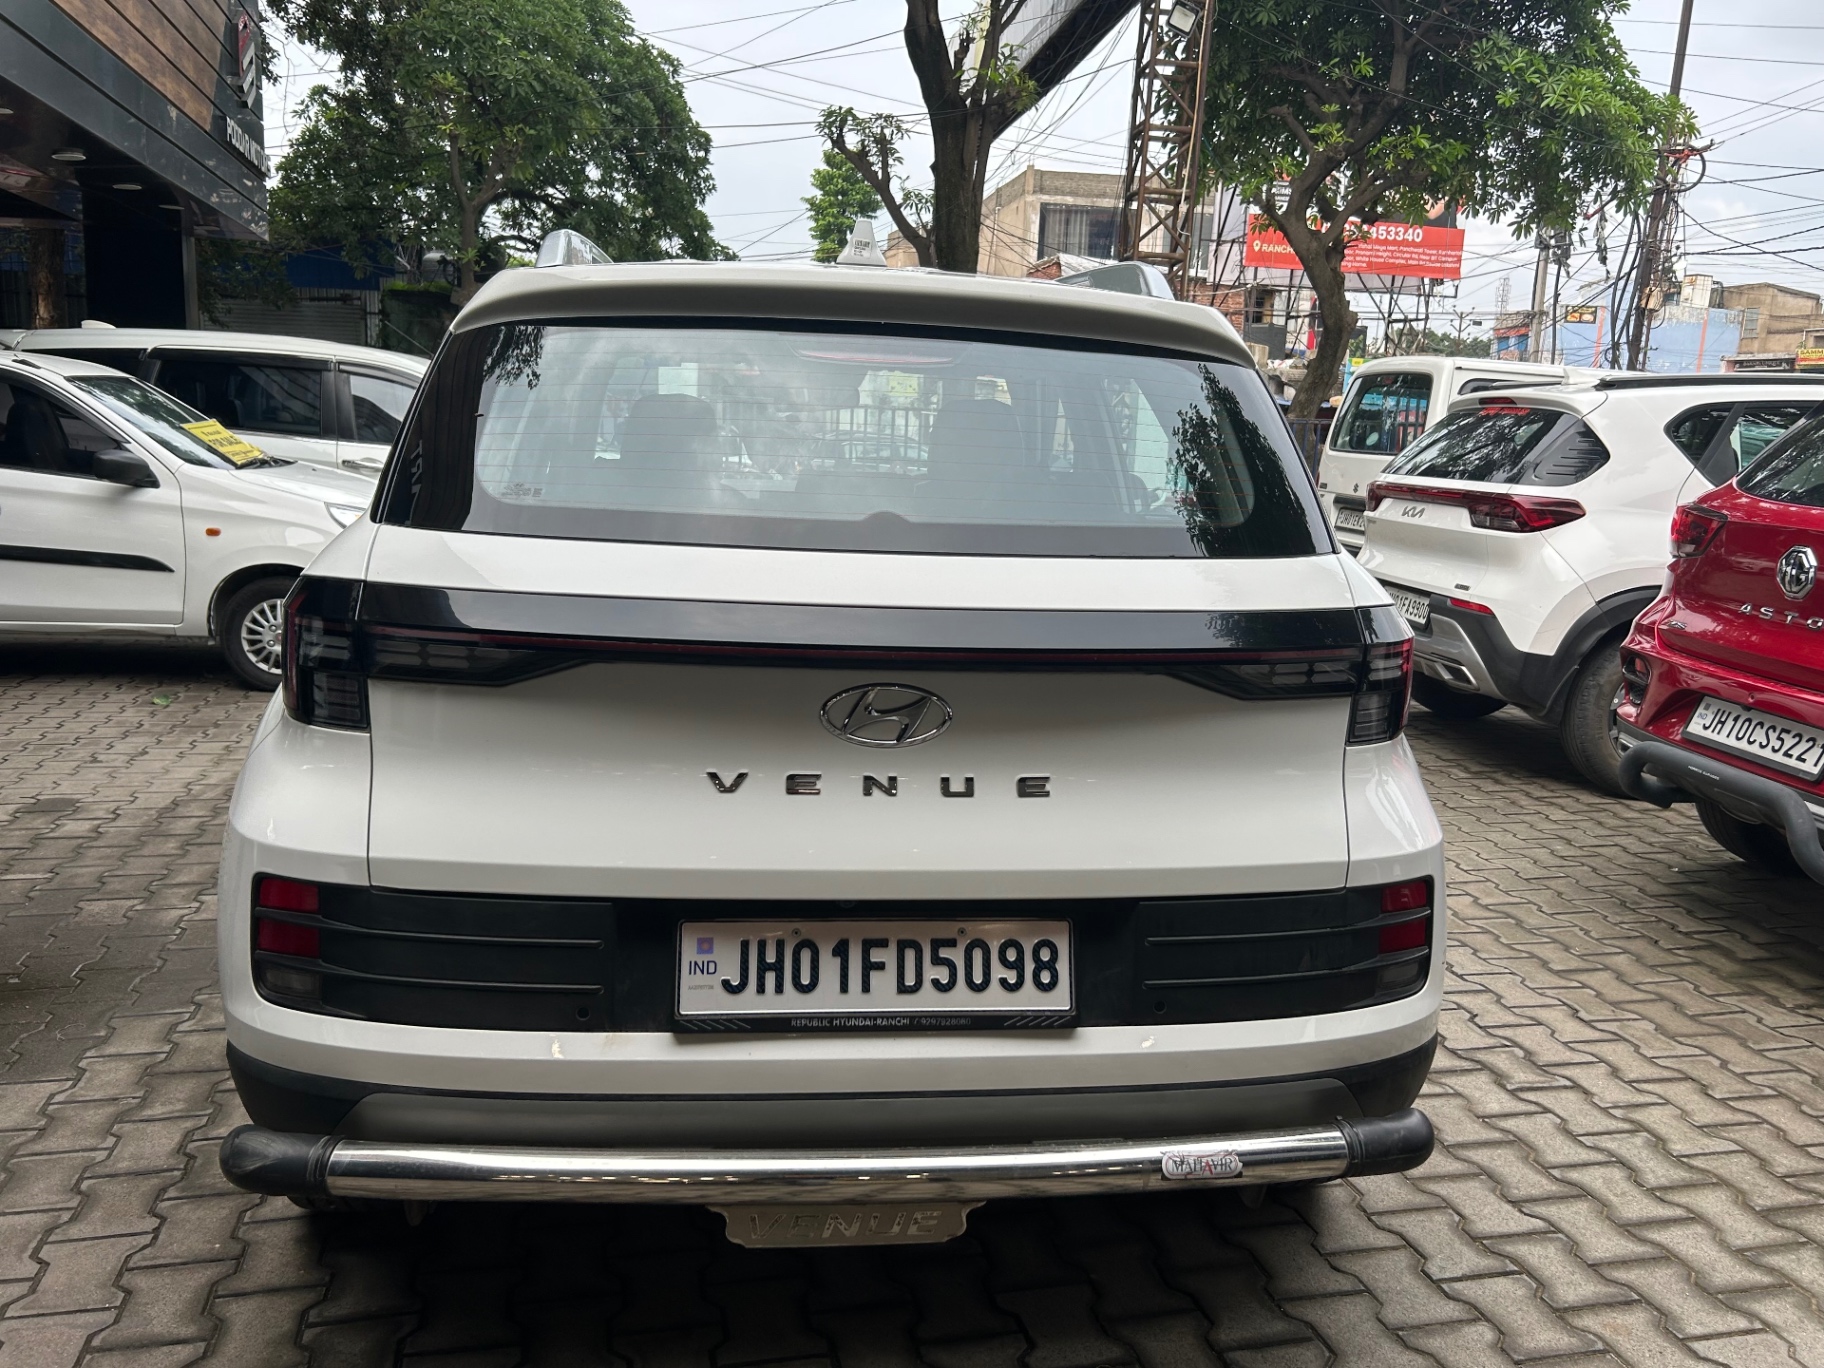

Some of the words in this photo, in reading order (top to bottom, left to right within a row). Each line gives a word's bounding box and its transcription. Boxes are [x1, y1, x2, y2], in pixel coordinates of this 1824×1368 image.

[1262, 243, 1296, 254] RANCH
[1702, 708, 1824, 767] JH10CS5221
[706, 771, 1050, 797] VENUE
[688, 960, 717, 975] IND
[720, 938, 1060, 994] JH01FD5098
[791, 1018, 830, 1027] REPUBLIC
[833, 1017, 910, 1027] HYUNDAI-RANCHI
[749, 1211, 942, 1239] VENUE
